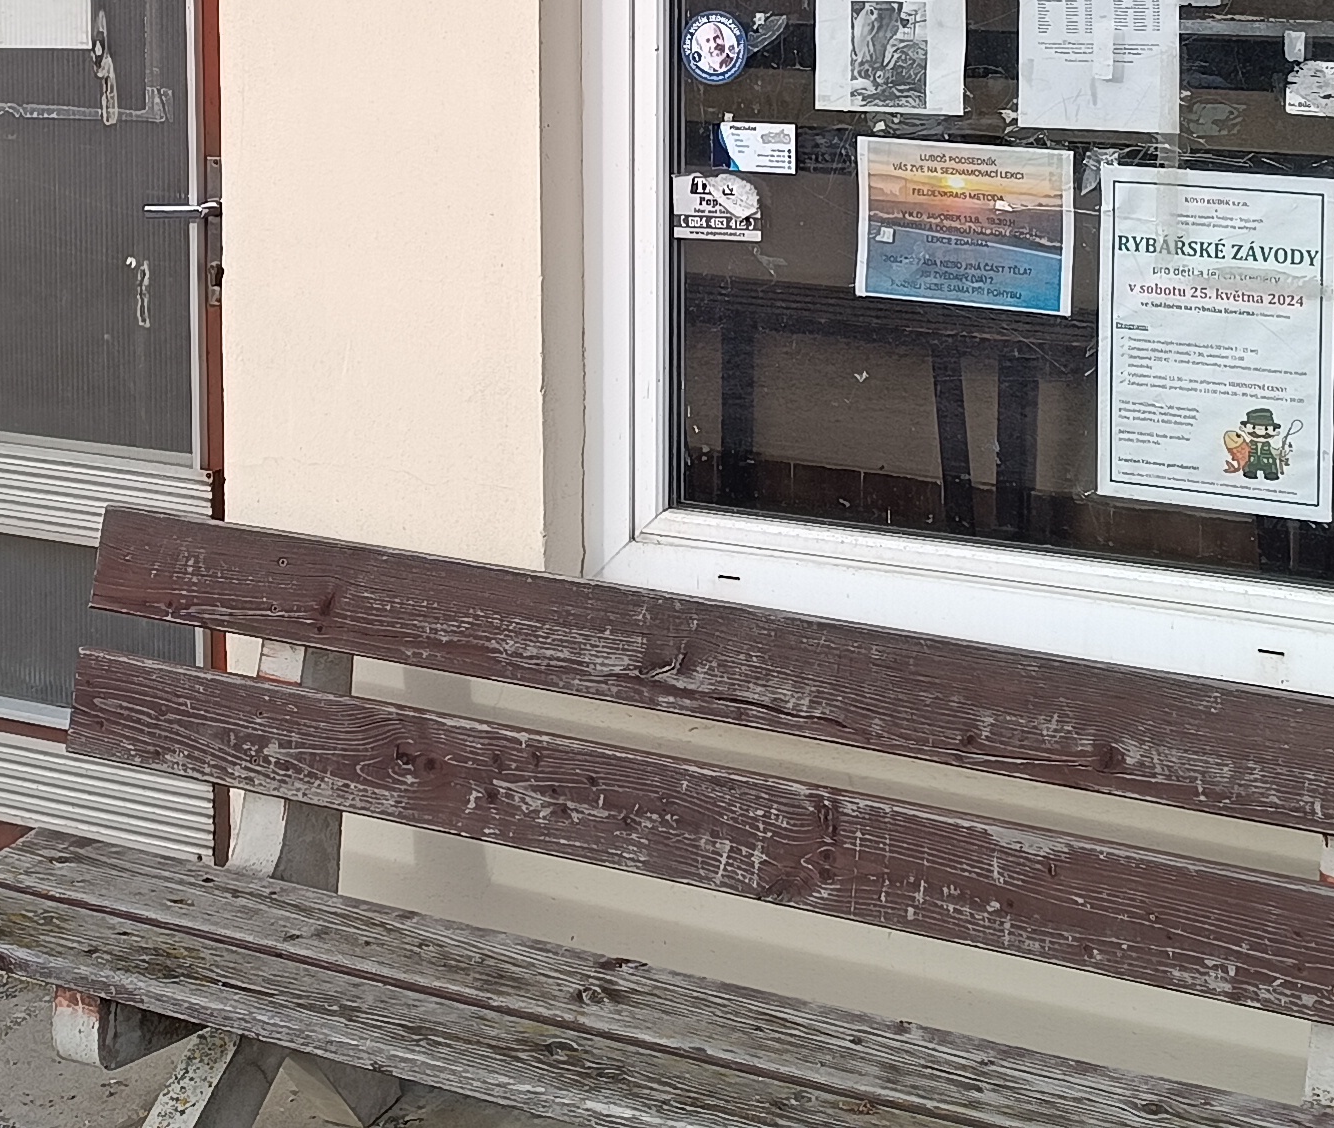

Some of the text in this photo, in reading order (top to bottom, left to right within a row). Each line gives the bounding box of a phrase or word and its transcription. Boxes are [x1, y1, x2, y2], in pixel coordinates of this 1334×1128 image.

[1118, 234, 1319, 266] RYBÁŘSKÉ ZÁVODY
[1128, 283, 1304, 307] v sobotu 25. května 2024
